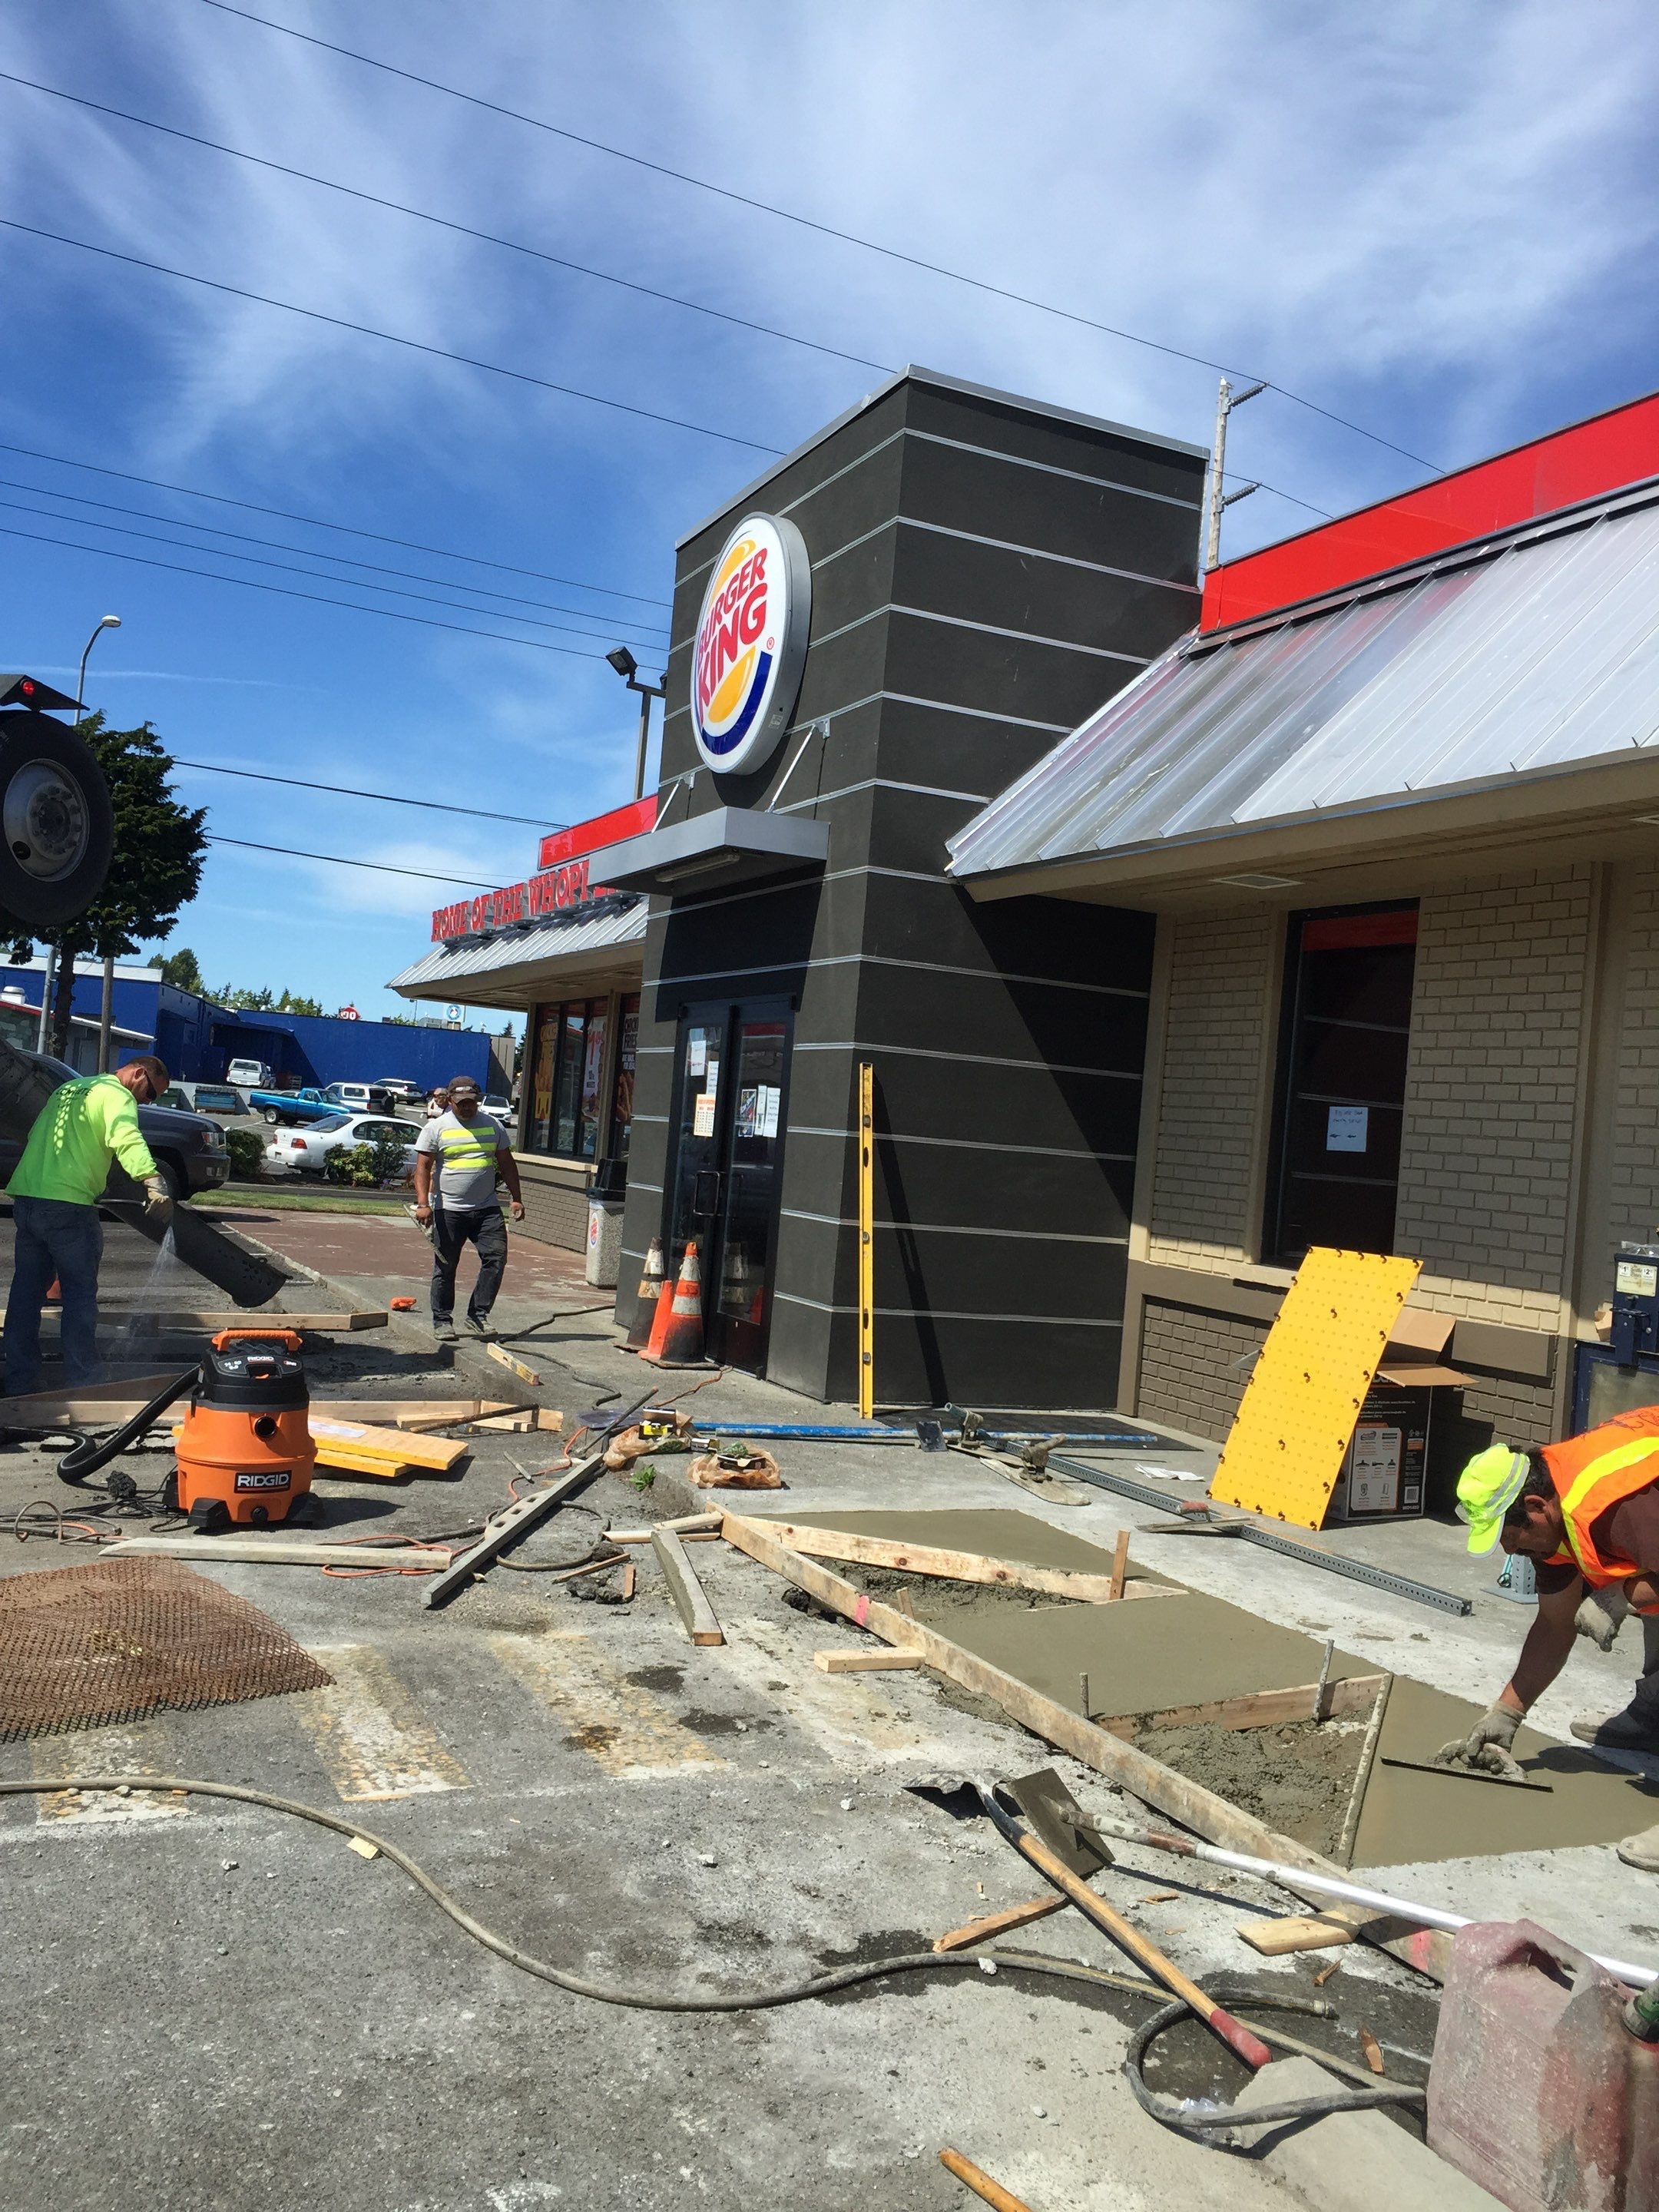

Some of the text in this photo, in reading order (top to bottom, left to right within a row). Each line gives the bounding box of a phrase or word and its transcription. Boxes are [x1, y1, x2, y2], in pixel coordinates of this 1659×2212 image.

[697, 547, 768, 667] BURGER
[698, 582, 768, 726] KING
[431, 900, 469, 942] HOME
[471, 893, 491, 932] OF
[493, 883, 524, 926] THE
[237, 1473, 290, 1487] RIDGID
